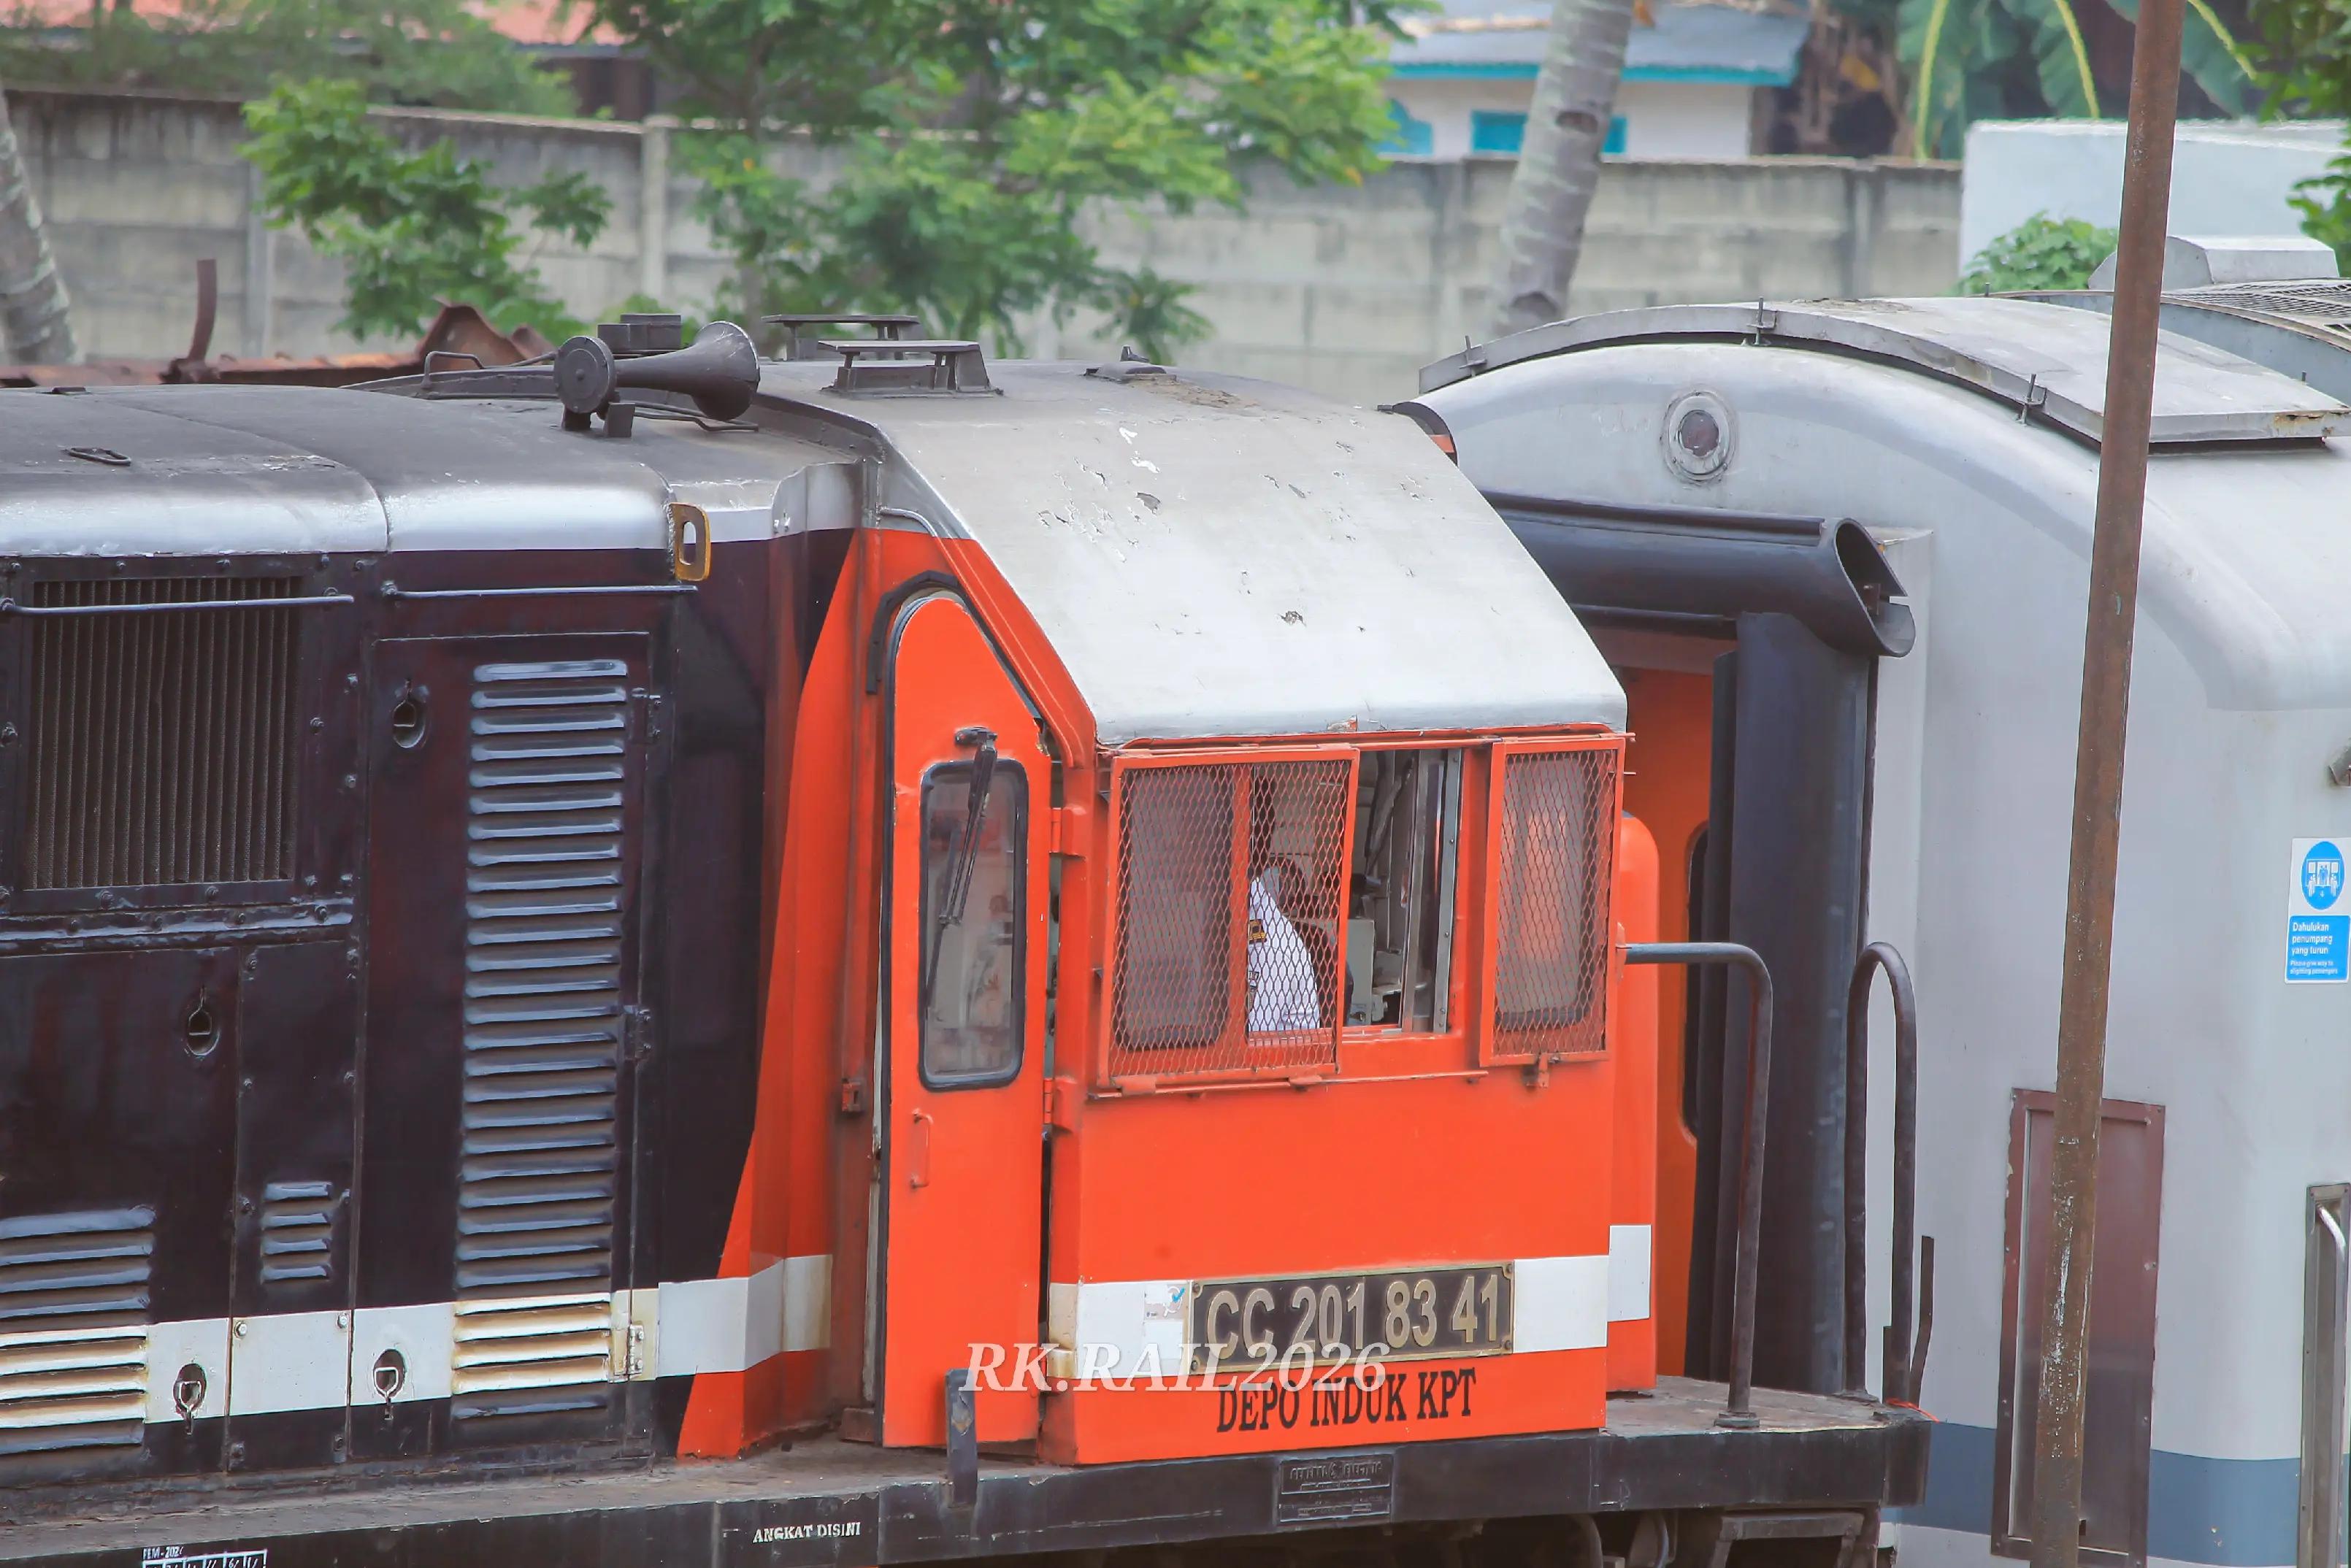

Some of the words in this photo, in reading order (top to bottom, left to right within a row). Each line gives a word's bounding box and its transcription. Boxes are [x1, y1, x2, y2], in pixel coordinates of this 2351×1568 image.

[2293, 922, 2329, 931] Dahulukan
[2292, 935, 2333, 945] penumpang
[2291, 947, 2309, 956] yang
[2310, 946, 2328, 954] turun
[1207, 1288, 1276, 1360] CC
[1292, 1283, 1365, 1355] 201
[1387, 1279, 1438, 1349] 83
[1452, 1275, 1498, 1344] 41
[1217, 1379, 1300, 1434] DEPO
[1311, 1373, 1408, 1427] INDUK
[1417, 1367, 1476, 1420] KPT
[752, 1524, 813, 1544] ANGKAT
[817, 1522, 861, 1538] DISINI
